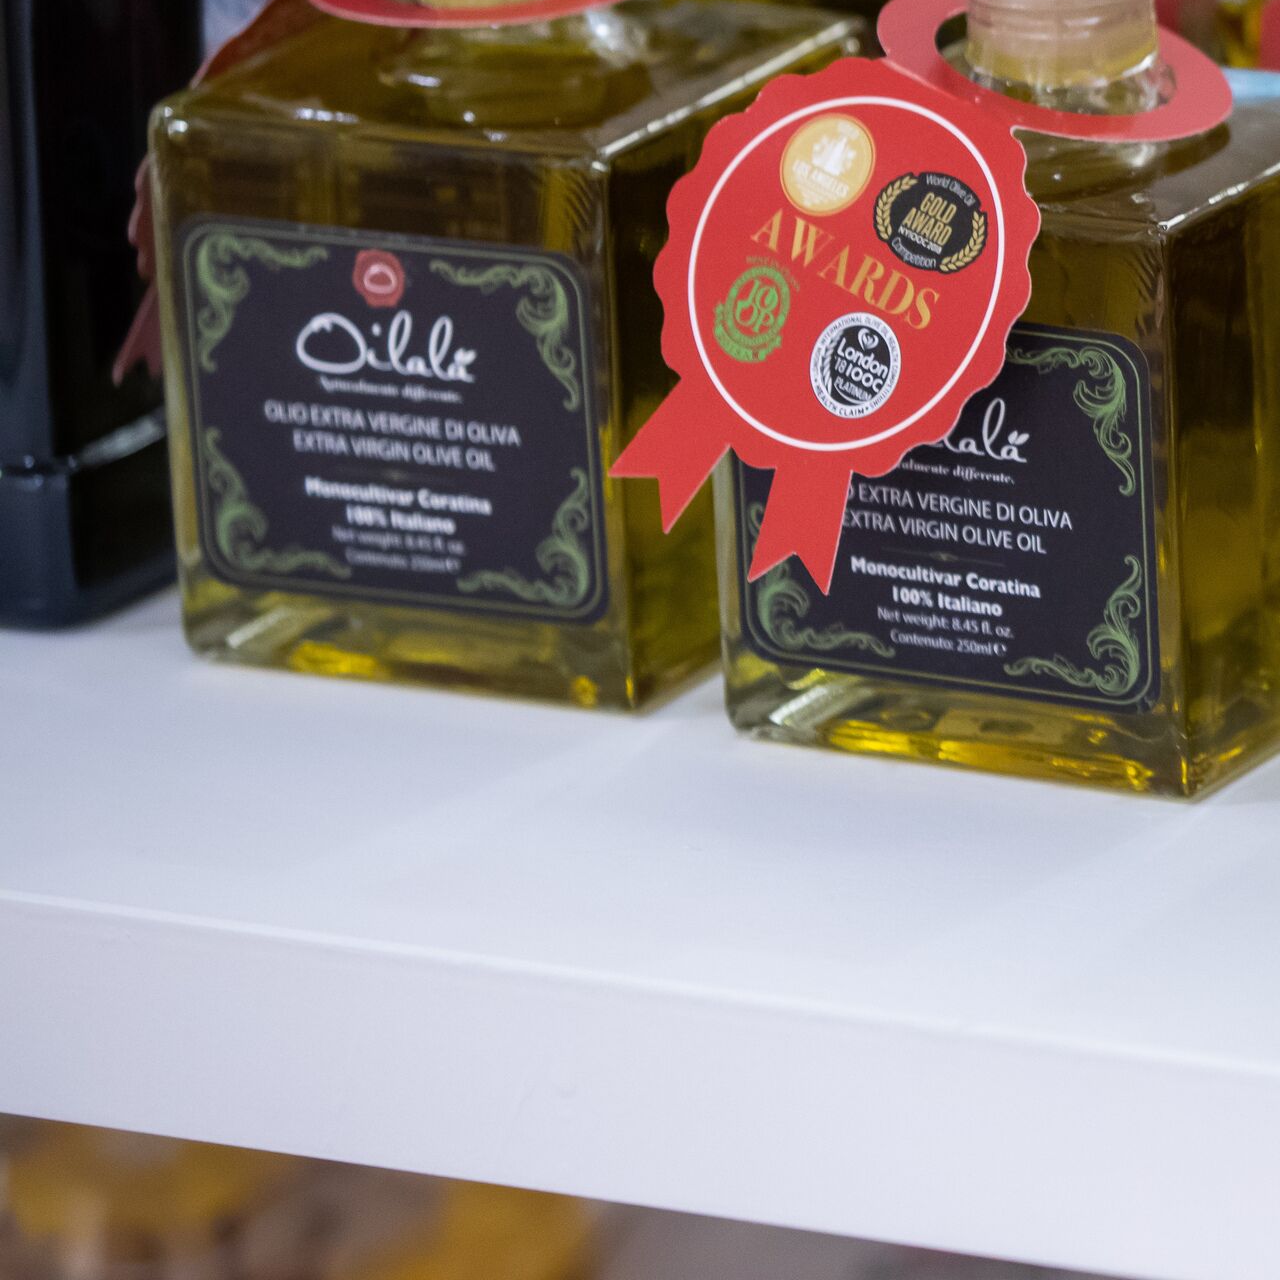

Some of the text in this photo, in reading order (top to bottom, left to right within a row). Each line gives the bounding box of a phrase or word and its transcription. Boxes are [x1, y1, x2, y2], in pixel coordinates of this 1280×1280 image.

[926, 174, 950, 189] World
[902, 207, 952, 246] AWARD
[920, 192, 957, 224] GOLD
[750, 207, 941, 330] AWARDS
[891, 237, 936, 269] Competition
[837, 337, 888, 379] London
[834, 376, 872, 401] PLATINUM
[263, 399, 520, 447] OLIO EXTRA VERGINE DI OLIVA
[839, 406, 864, 416] CLAIM
[293, 430, 496, 472] EXTRA VIRGIN OLIVE OIL
[304, 475, 492, 515] Monocultivar Coratina
[859, 483, 914, 508] EXTRA
[917, 491, 992, 520] VERGINE
[996, 502, 1014, 522] DI
[1018, 506, 1072, 530] OLIVA
[842, 509, 1047, 554] EXTRA VIRGIN OLIVE OIL
[851, 555, 1041, 598] Monocultivar Coratina
[877, 607, 899, 622] Net
[892, 585, 1003, 617] 100% Italiano
